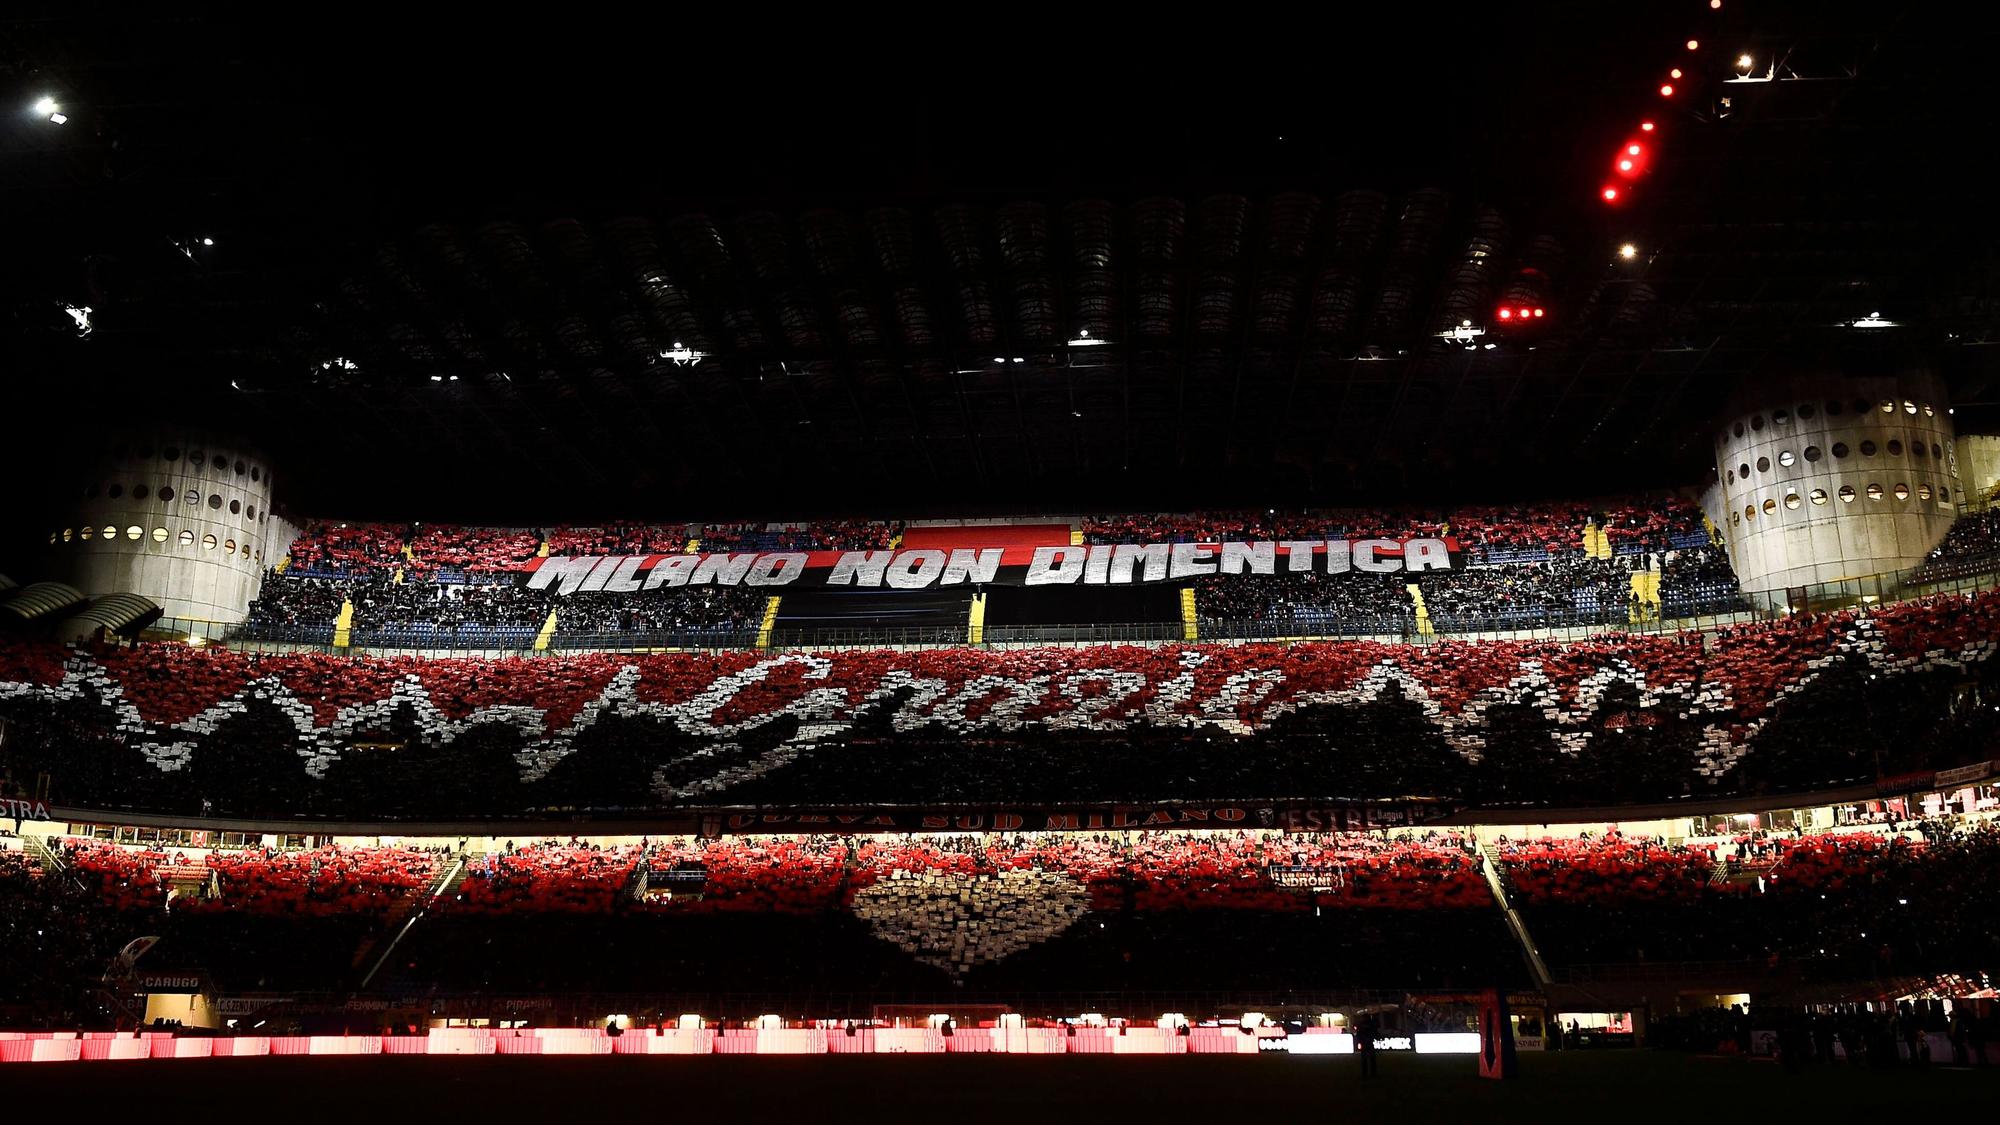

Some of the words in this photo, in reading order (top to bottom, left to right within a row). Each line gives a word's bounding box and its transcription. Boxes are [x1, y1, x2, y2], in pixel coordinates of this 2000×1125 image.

[526, 552, 806, 595] MILANO
[826, 547, 1004, 589] NON
[1025, 538, 1451, 585] DIMENTICA
[922, 813, 1024, 830] SUD
[1044, 807, 1247, 830] MILANO
[145, 977, 199, 988] CARUGO
